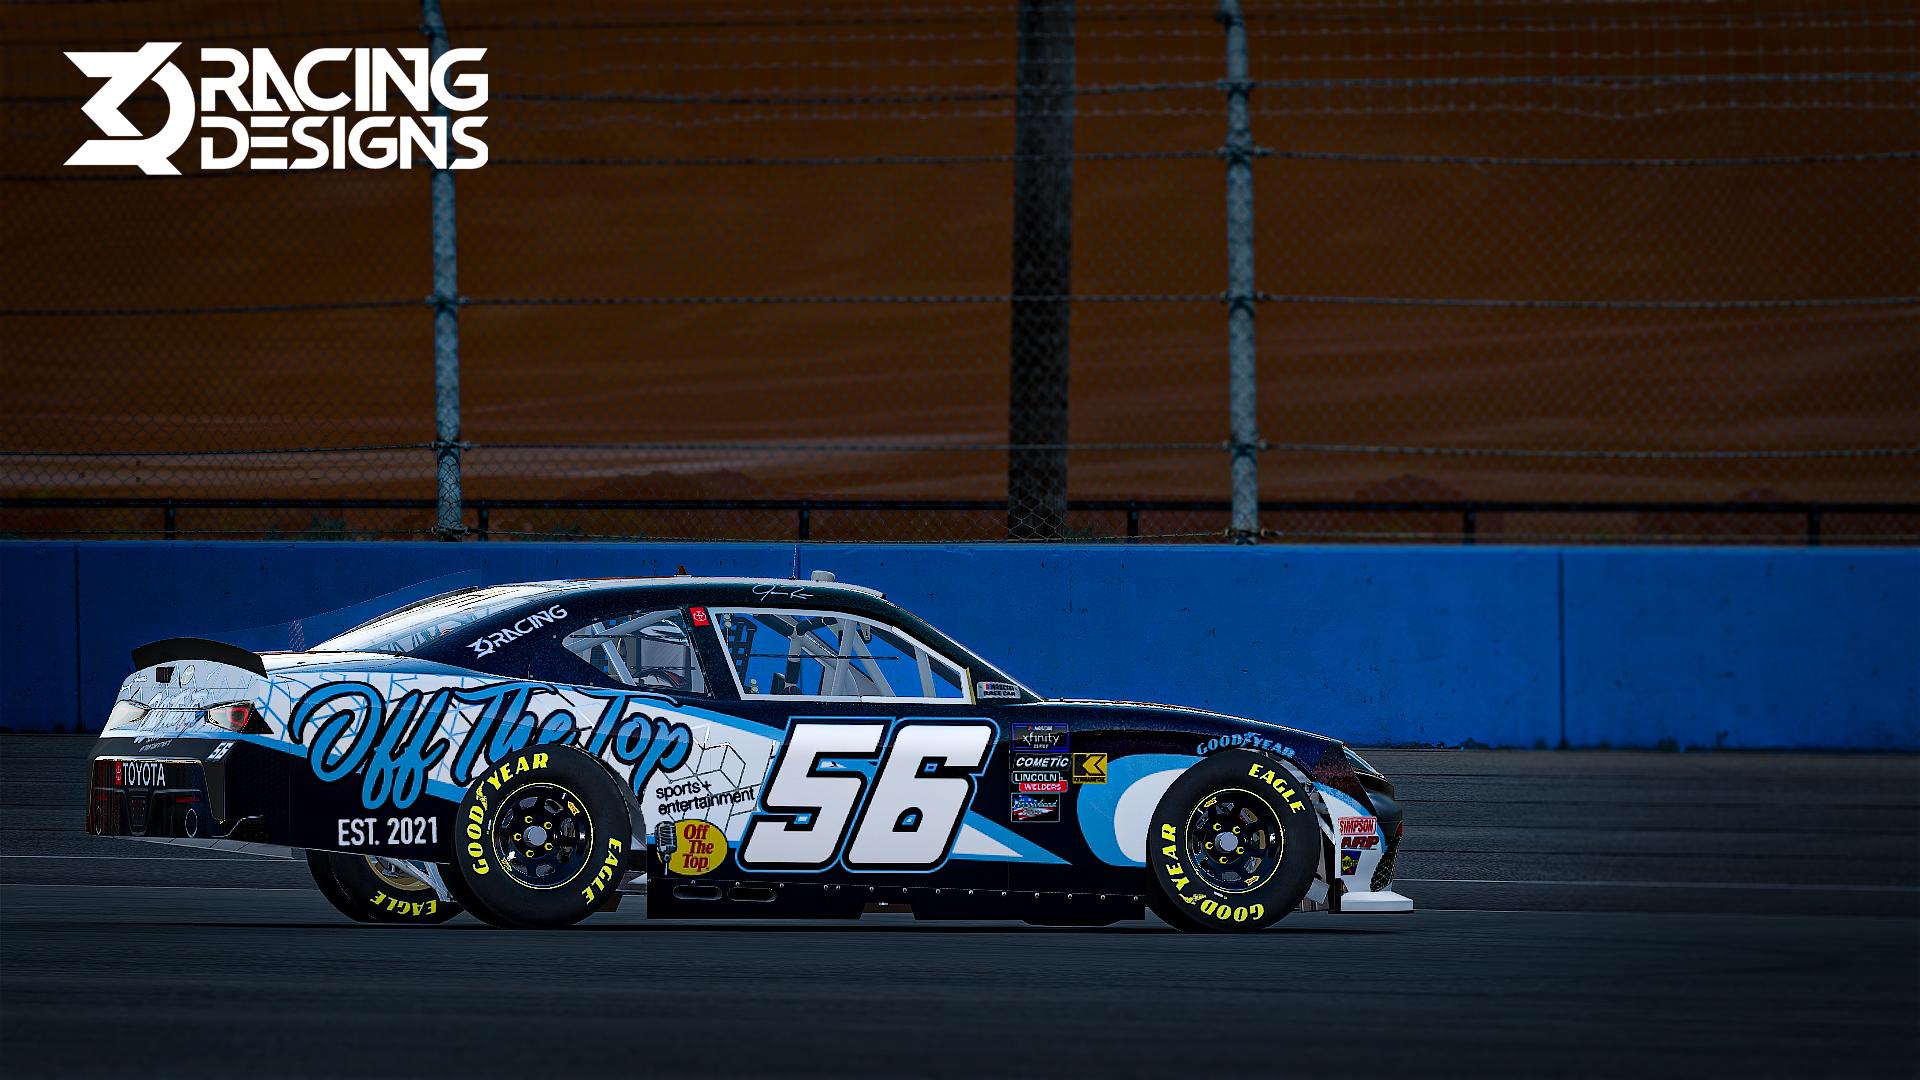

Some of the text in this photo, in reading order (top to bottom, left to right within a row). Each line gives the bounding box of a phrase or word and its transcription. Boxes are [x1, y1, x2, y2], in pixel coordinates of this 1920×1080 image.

[487, 604, 568, 648] RACING
[289, 680, 694, 810] Off The Top
[1022, 731, 1060, 746] xfinity
[1196, 732, 1296, 760] GOODYEAR
[122, 762, 166, 787] TOYOTA
[1016, 755, 1069, 767] COMETIC
[1014, 773, 1057, 782] LINCOLN
[1024, 783, 1062, 791] WELDERS
[1247, 763, 1306, 814] EAGLE
[658, 787, 756, 815] entertainment
[736, 716, 1000, 874] 56
[466, 752, 549, 875] GOODYEAR
[337, 816, 438, 846] EST. 2021
[683, 823, 710, 840] Off
[1340, 836, 1380, 849] ARP
[688, 839, 714, 855] The
[581, 837, 622, 905] EAGLE
[1161, 823, 1265, 922] GOODYEAR
[369, 890, 437, 916] EAGLE
